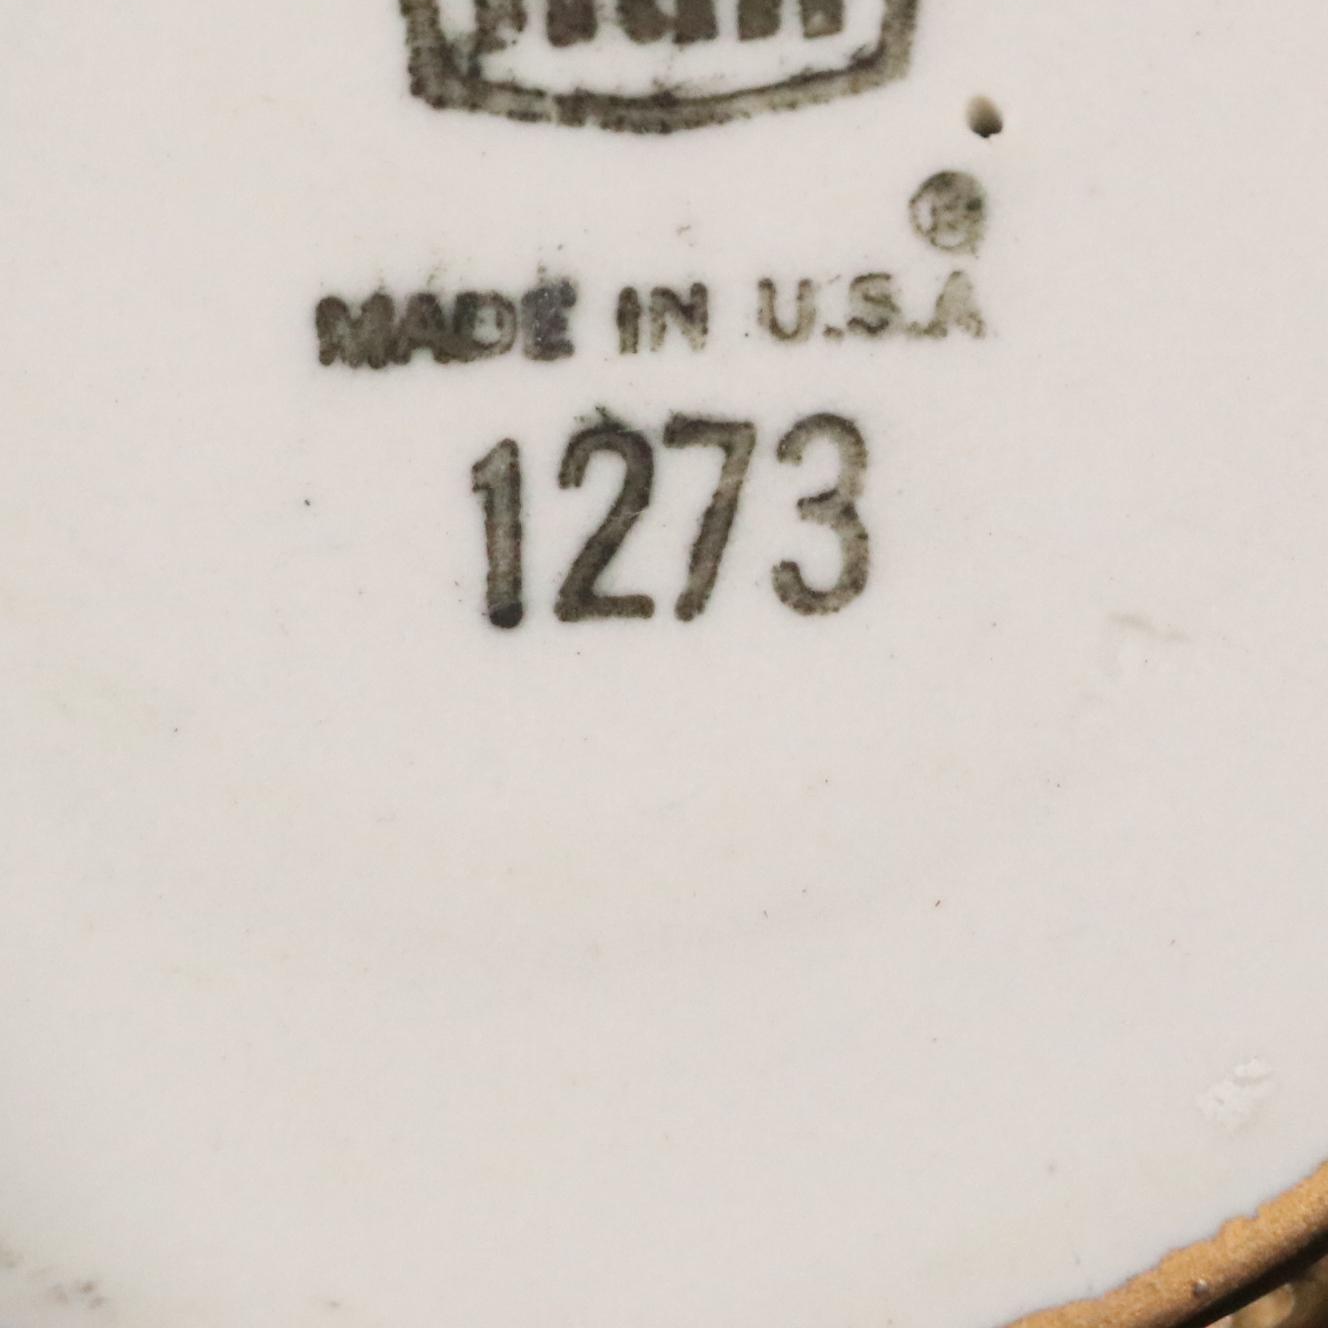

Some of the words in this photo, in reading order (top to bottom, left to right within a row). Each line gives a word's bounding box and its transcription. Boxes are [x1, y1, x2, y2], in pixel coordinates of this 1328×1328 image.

[314, 282, 577, 369] MADE
[616, 280, 709, 356] IN
[471, 411, 871, 628] 1273
